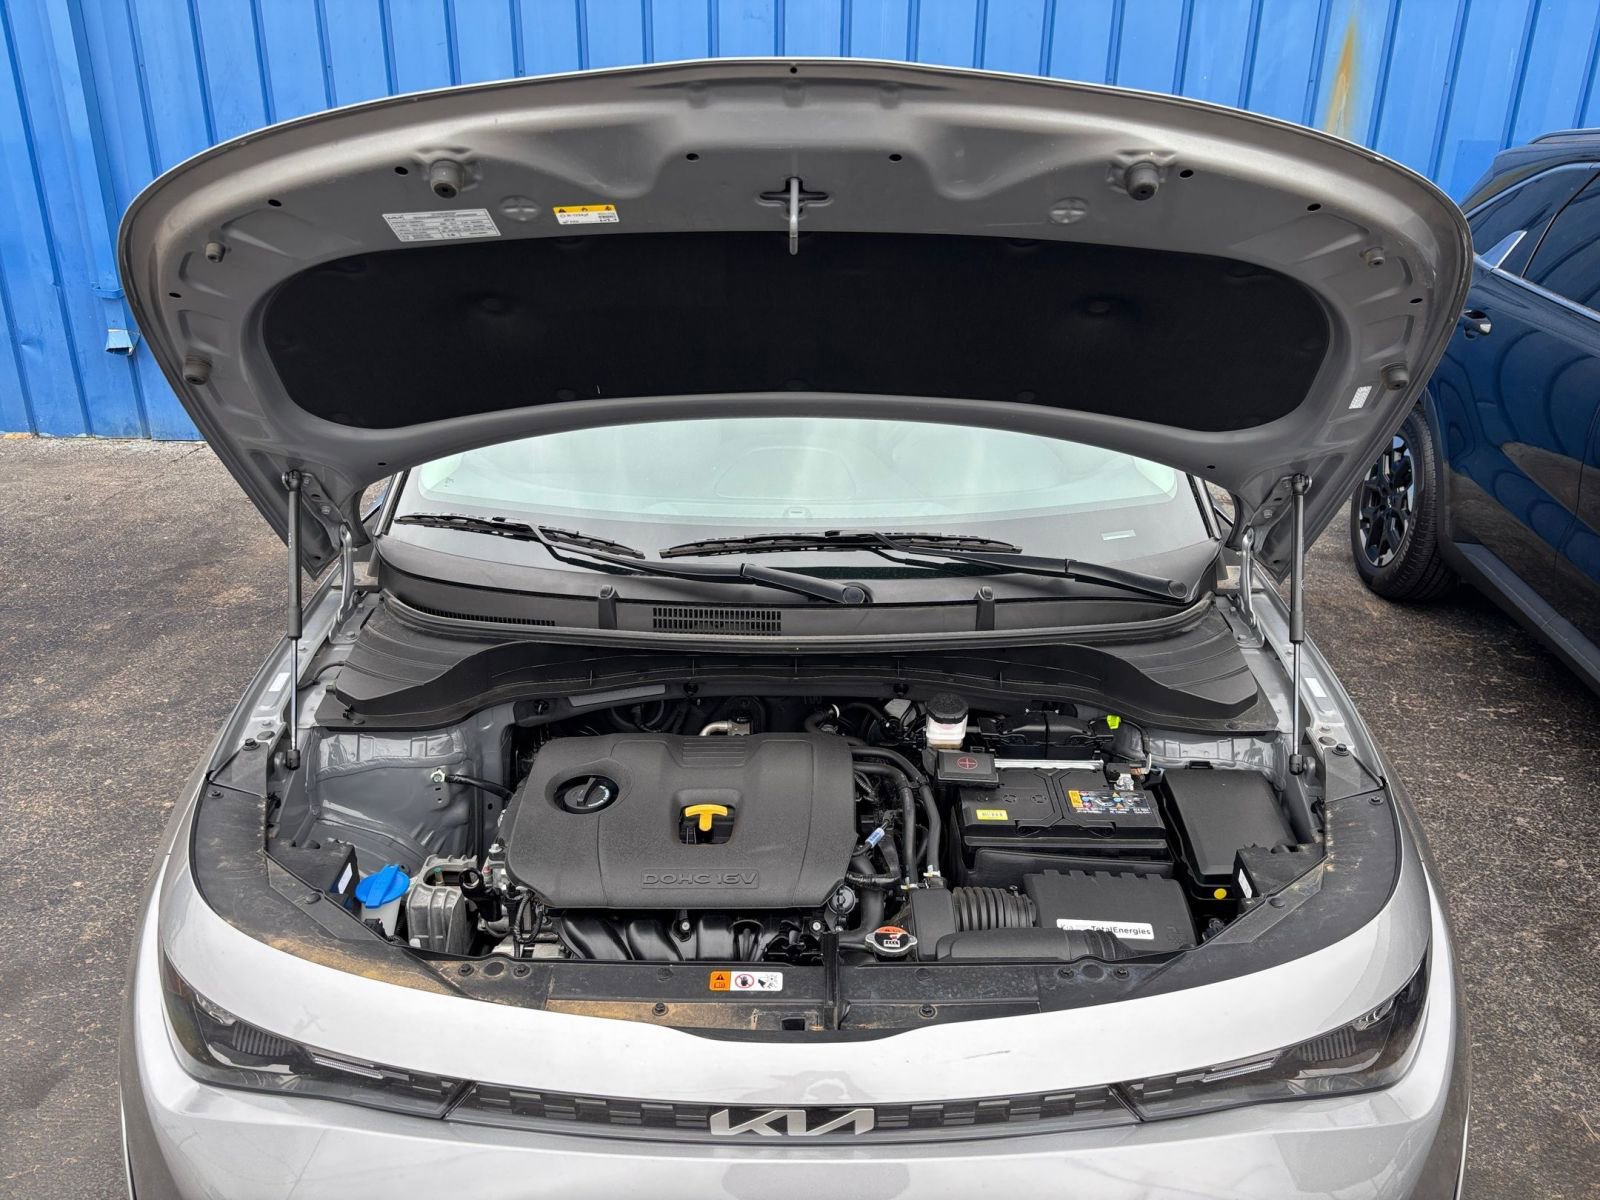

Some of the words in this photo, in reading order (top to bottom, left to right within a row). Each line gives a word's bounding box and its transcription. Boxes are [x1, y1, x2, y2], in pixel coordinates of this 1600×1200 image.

[643, 872, 711, 884] DOHC
[717, 872, 757, 884] 16V
[1091, 925, 1151, 935] TotalEnergies
[709, 1108, 875, 1136] KIA
